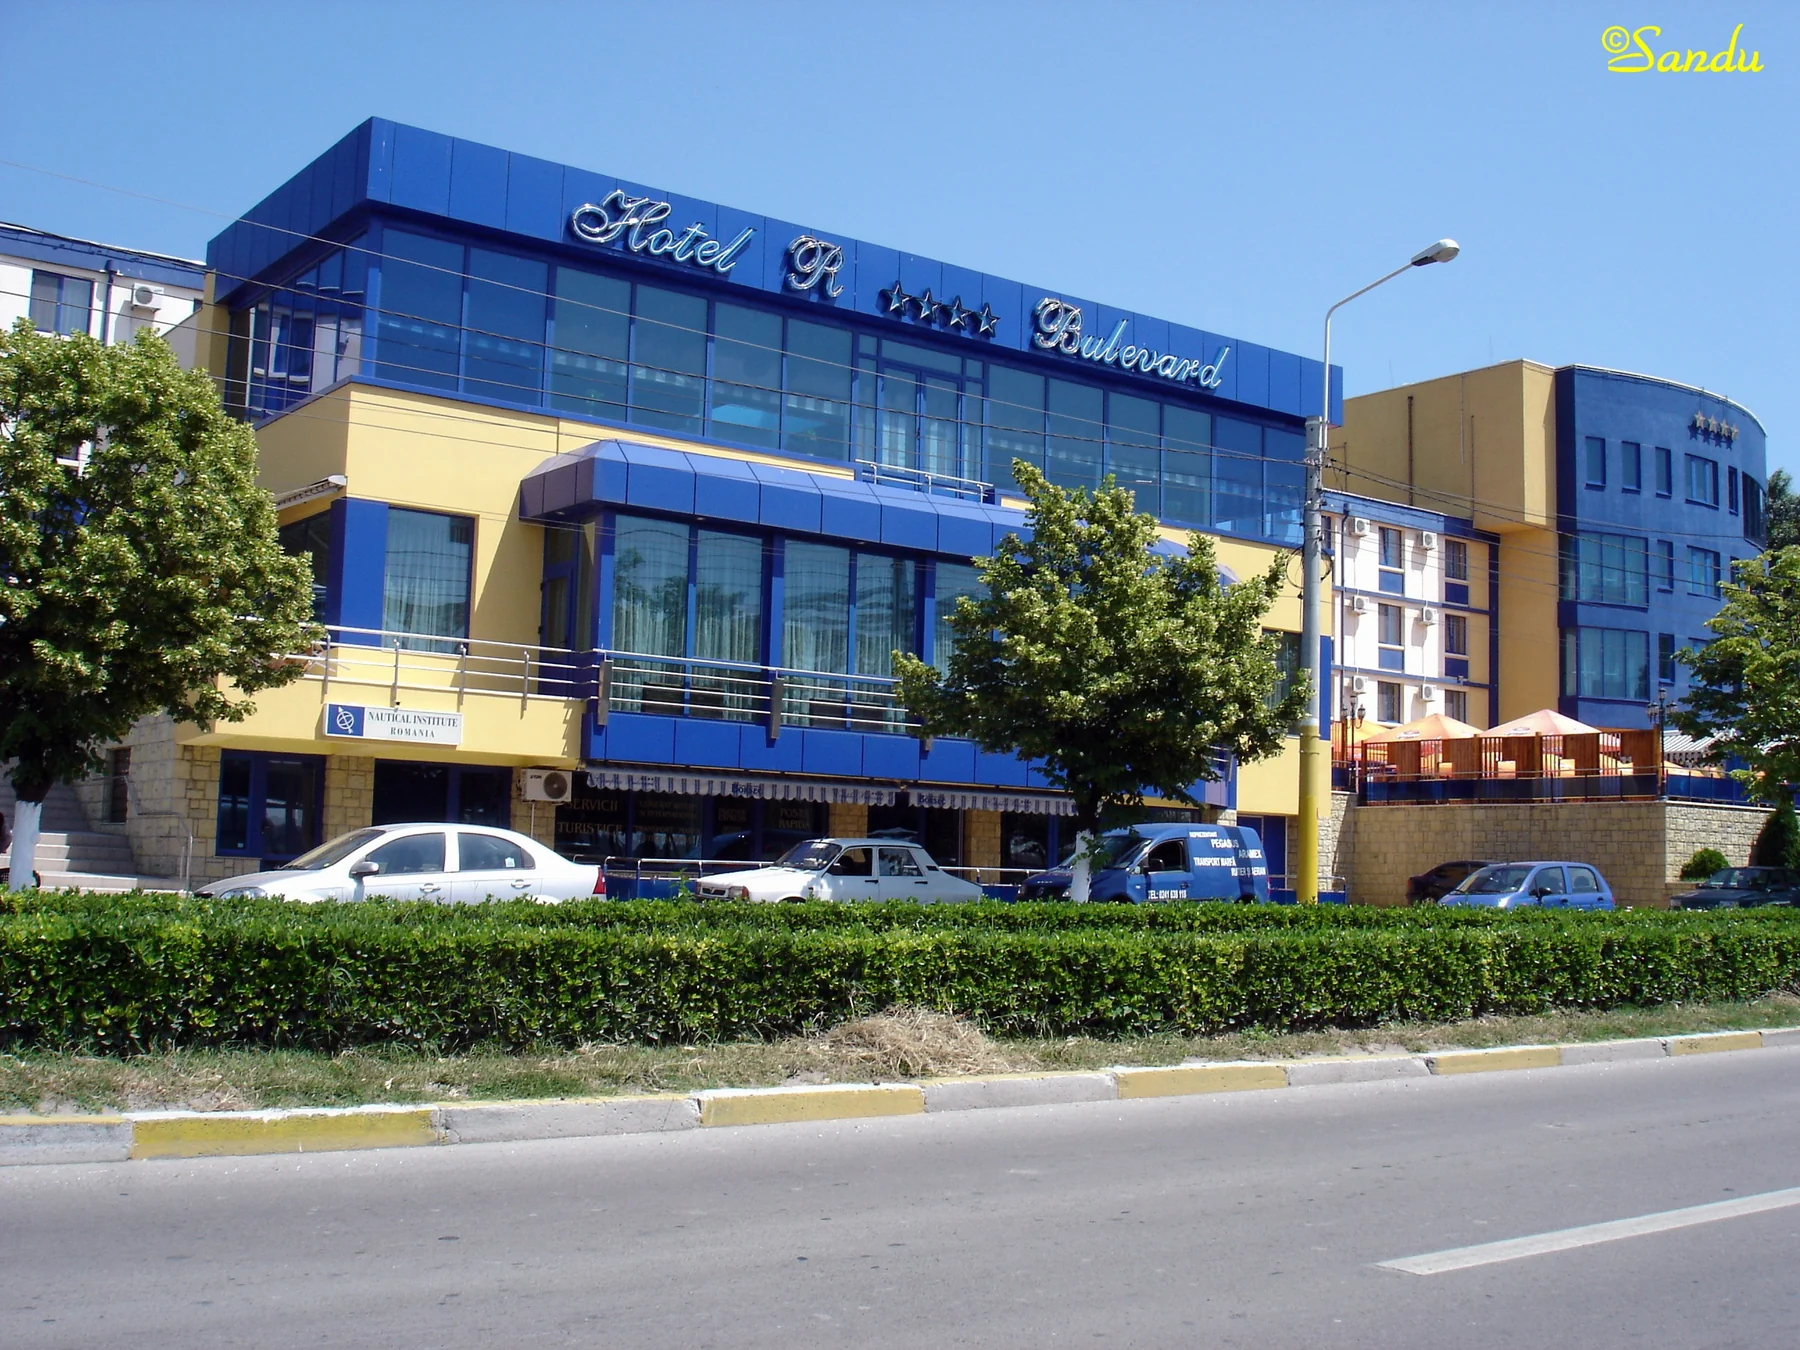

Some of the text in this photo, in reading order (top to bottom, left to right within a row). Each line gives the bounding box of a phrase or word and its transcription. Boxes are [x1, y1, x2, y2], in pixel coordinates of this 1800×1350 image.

[571, 189, 757, 274] Hotel
[1032, 297, 1232, 388] Bulevard
[368, 711, 458, 728] NAUTICAL INSTITUTE
[390, 727, 435, 738] ROMANIA
[564, 798, 618, 811] SERVICII
[1211, 838, 1239, 848] PEGASUS
[1193, 857, 1220, 866] TRANSPORT
